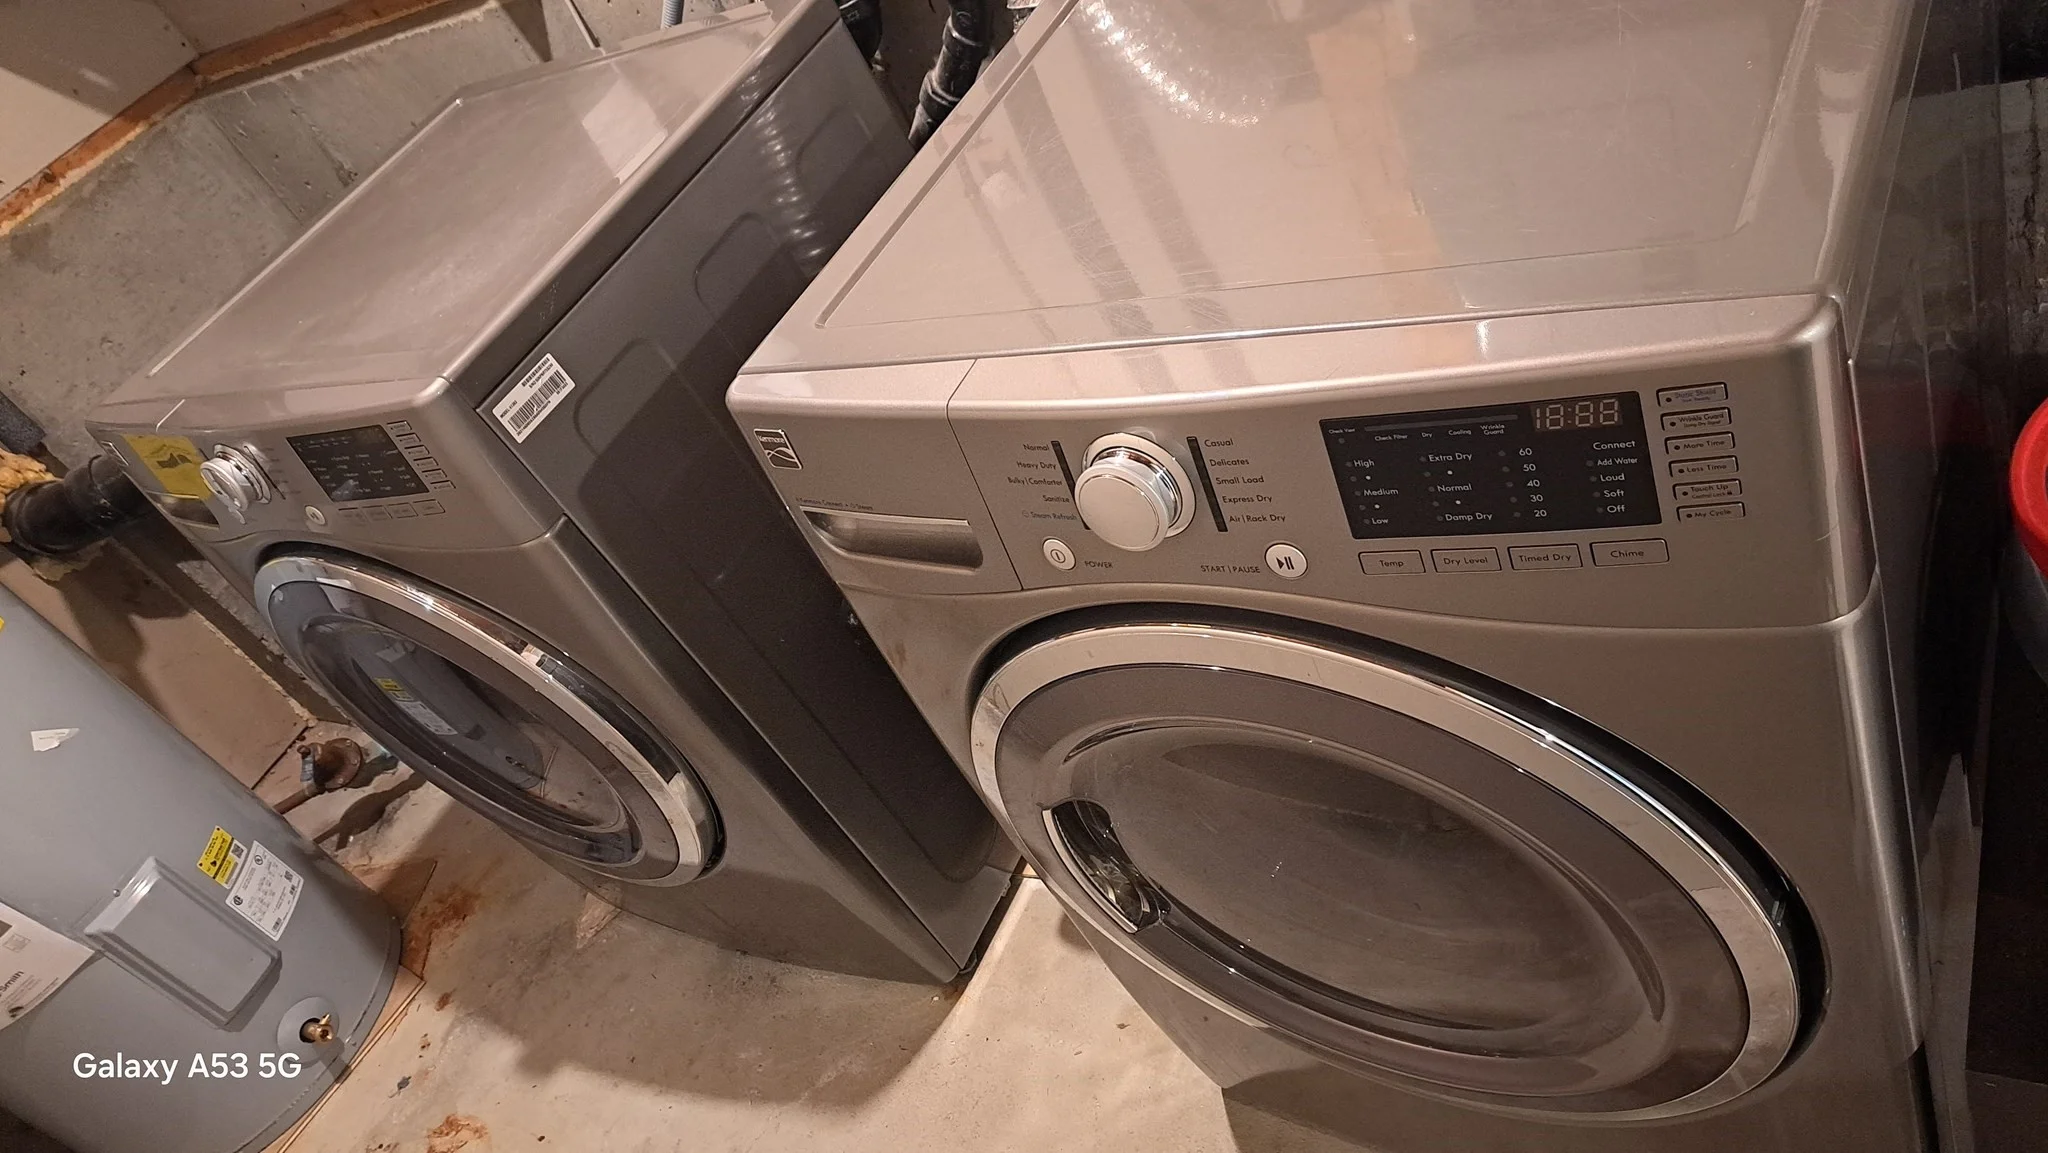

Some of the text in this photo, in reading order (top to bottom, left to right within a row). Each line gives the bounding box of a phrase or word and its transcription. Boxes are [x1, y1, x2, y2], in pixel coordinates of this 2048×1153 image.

[1703, 412, 1724, 420] Guard
[1421, 431, 1433, 439] Dry
[1448, 428, 1472, 436] Cooling
[1374, 434, 1393, 442] Check
[1023, 443, 1050, 452] Normal
[1204, 438, 1234, 448] Casual
[1593, 440, 1636, 450] Connect
[1684, 441, 1704, 449] More
[1518, 447, 1532, 456] 60
[1428, 452, 1473, 463] Extra Dry
[1597, 456, 1638, 467] Add Water
[1040, 461, 1057, 470] Duty
[1209, 458, 1249, 467] Delicates
[1354, 458, 1375, 469] High
[1522, 463, 1536, 472] 50
[1215, 475, 1265, 485] Small Load
[1600, 473, 1625, 482] Loud
[1437, 483, 1473, 492] Normal
[1526, 479, 1540, 488] 40
[1363, 488, 1399, 497] Medium
[1603, 489, 1625, 498] Soft
[1222, 494, 1273, 504] Express Dry
[1530, 494, 1544, 503] 30
[1606, 504, 1626, 513] Off
[1709, 509, 1732, 517] Cycle
[1445, 512, 1493, 523] Damp Dry
[1533, 509, 1547, 518] 20
[1269, 514, 1286, 523] Dry
[1371, 517, 1389, 525] Low
[1518, 553, 1572, 563] Timed Dry
[1610, 549, 1645, 559] Chime
[1084, 560, 1113, 569] POWER
[1379, 559, 1404, 569] Temp
[1443, 556, 1488, 566] Dry Level
[1200, 565, 1225, 573] START
[1232, 565, 1261, 574] PAUSE
